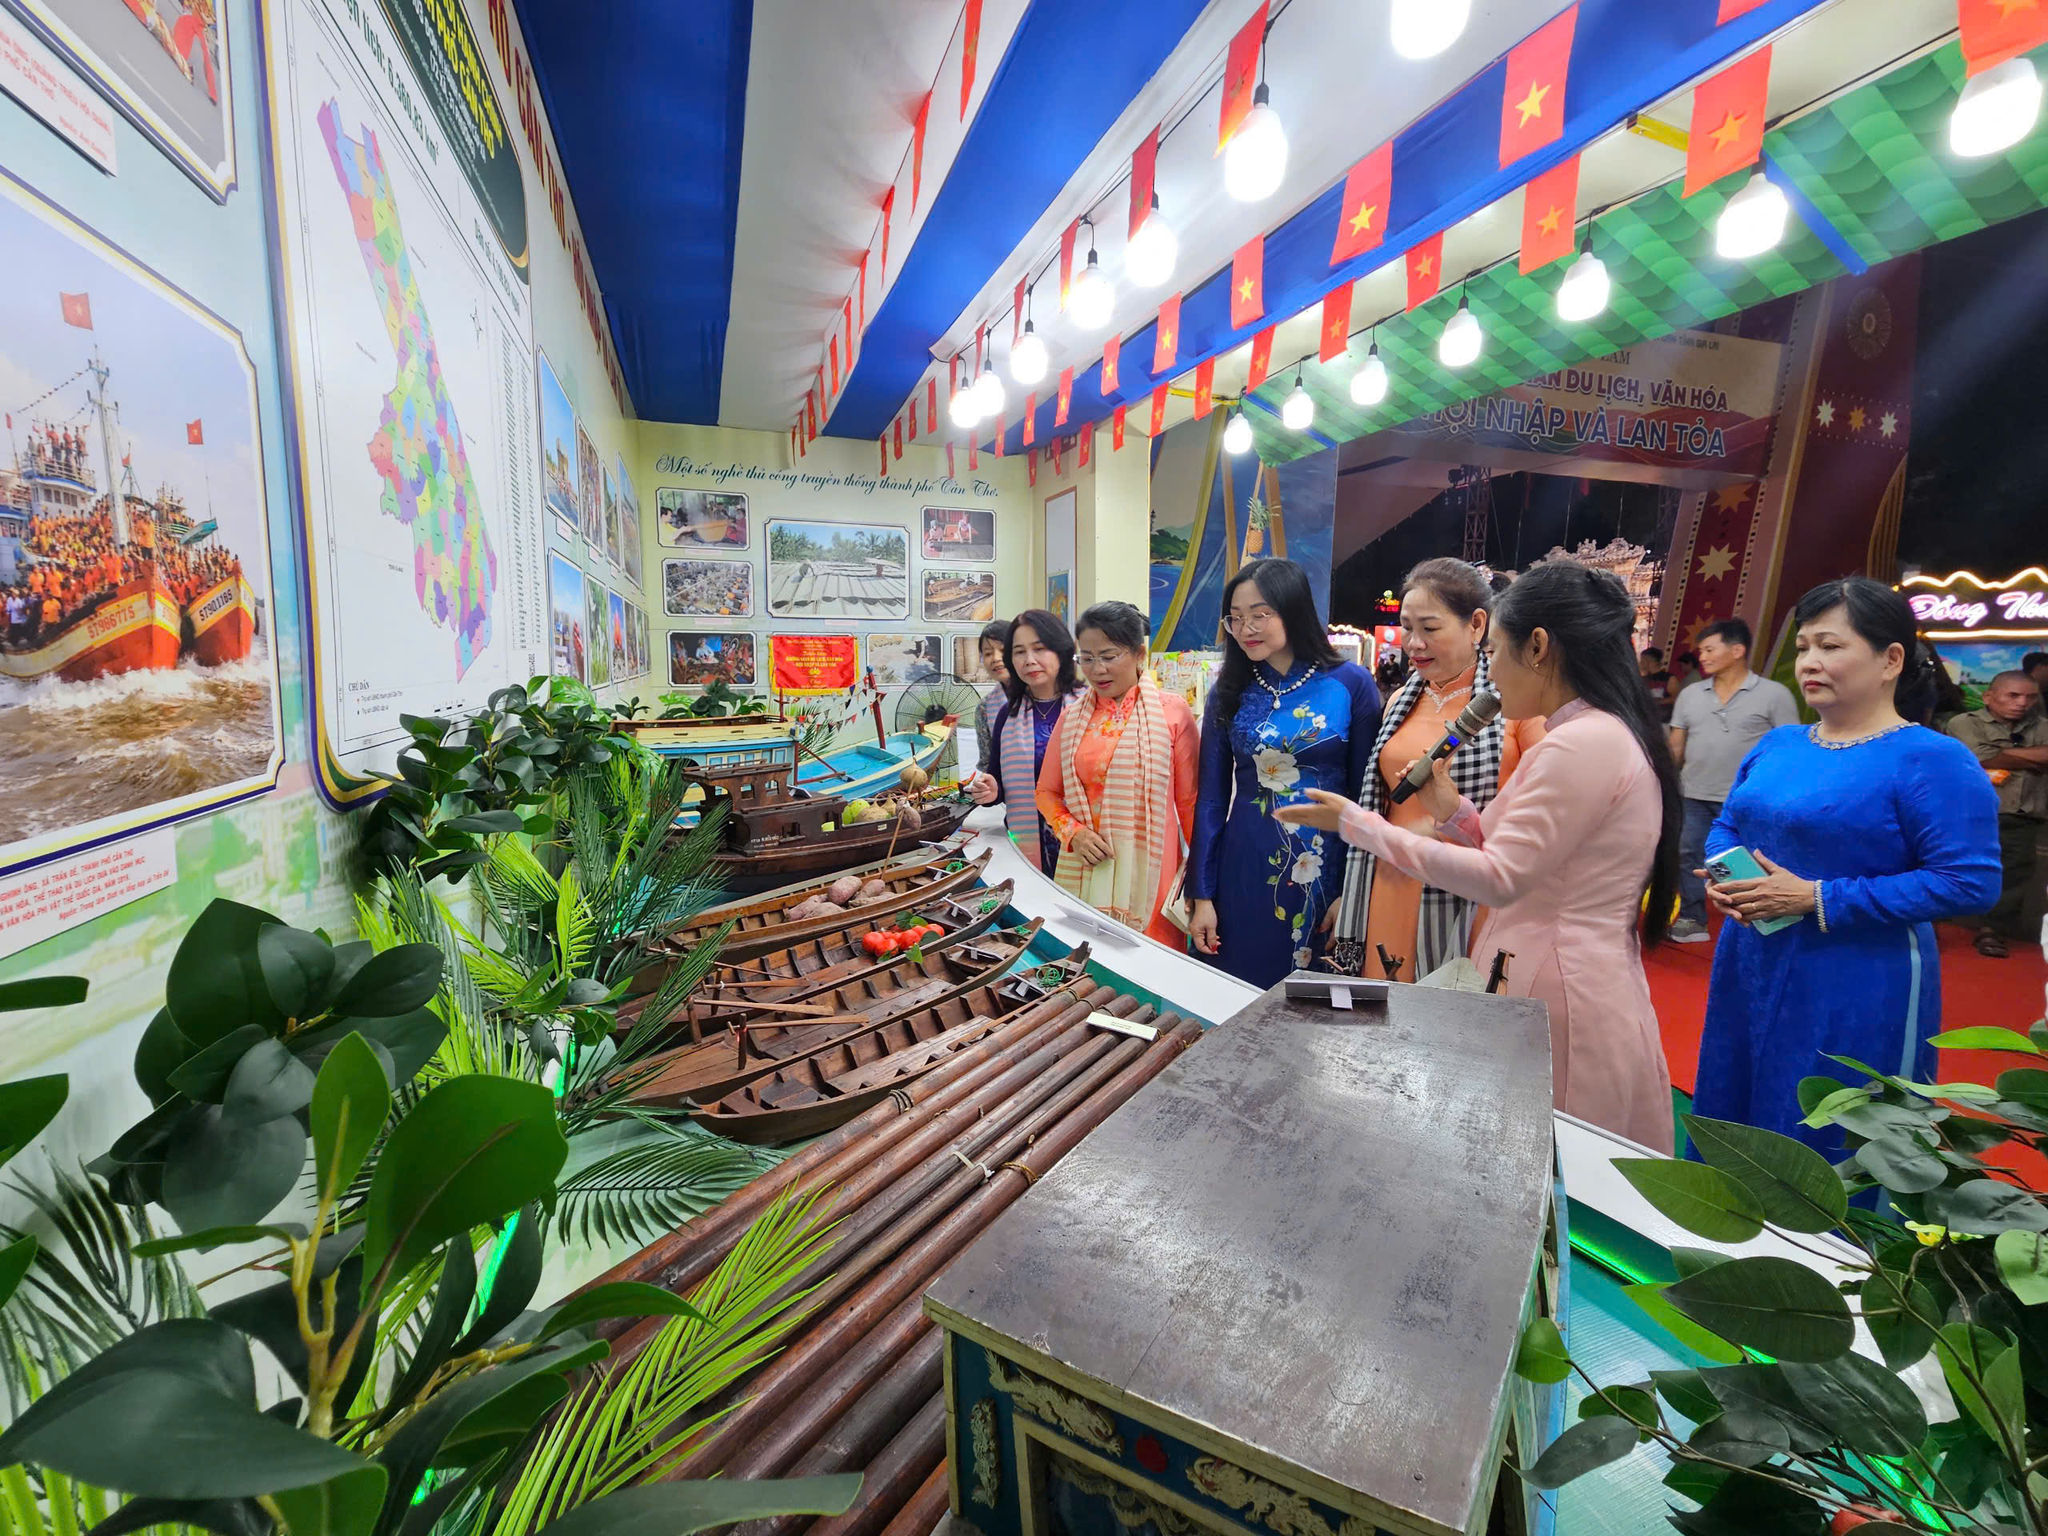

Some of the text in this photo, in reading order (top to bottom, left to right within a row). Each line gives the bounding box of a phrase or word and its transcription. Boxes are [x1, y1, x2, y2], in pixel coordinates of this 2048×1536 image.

[1565, 367, 1594, 395] DU
[1596, 372, 1644, 407] LỊCH,
[1649, 378, 1688, 408] VĂN
[1689, 383, 1730, 413] HÓA
[1421, 396, 1726, 458] ỘI NHẬP VÀ LAN TỎA
[656, 454, 693, 478] Một
[694, 461, 713, 475] số
[711, 462, 745, 485] nghề
[746, 464, 767, 481] thủ
[768, 469, 798, 490] công
[800, 469, 841, 492] truyền
[843, 472, 878, 496] thống
[879, 476, 913, 492] thành
[911, 478, 940, 498] phố
